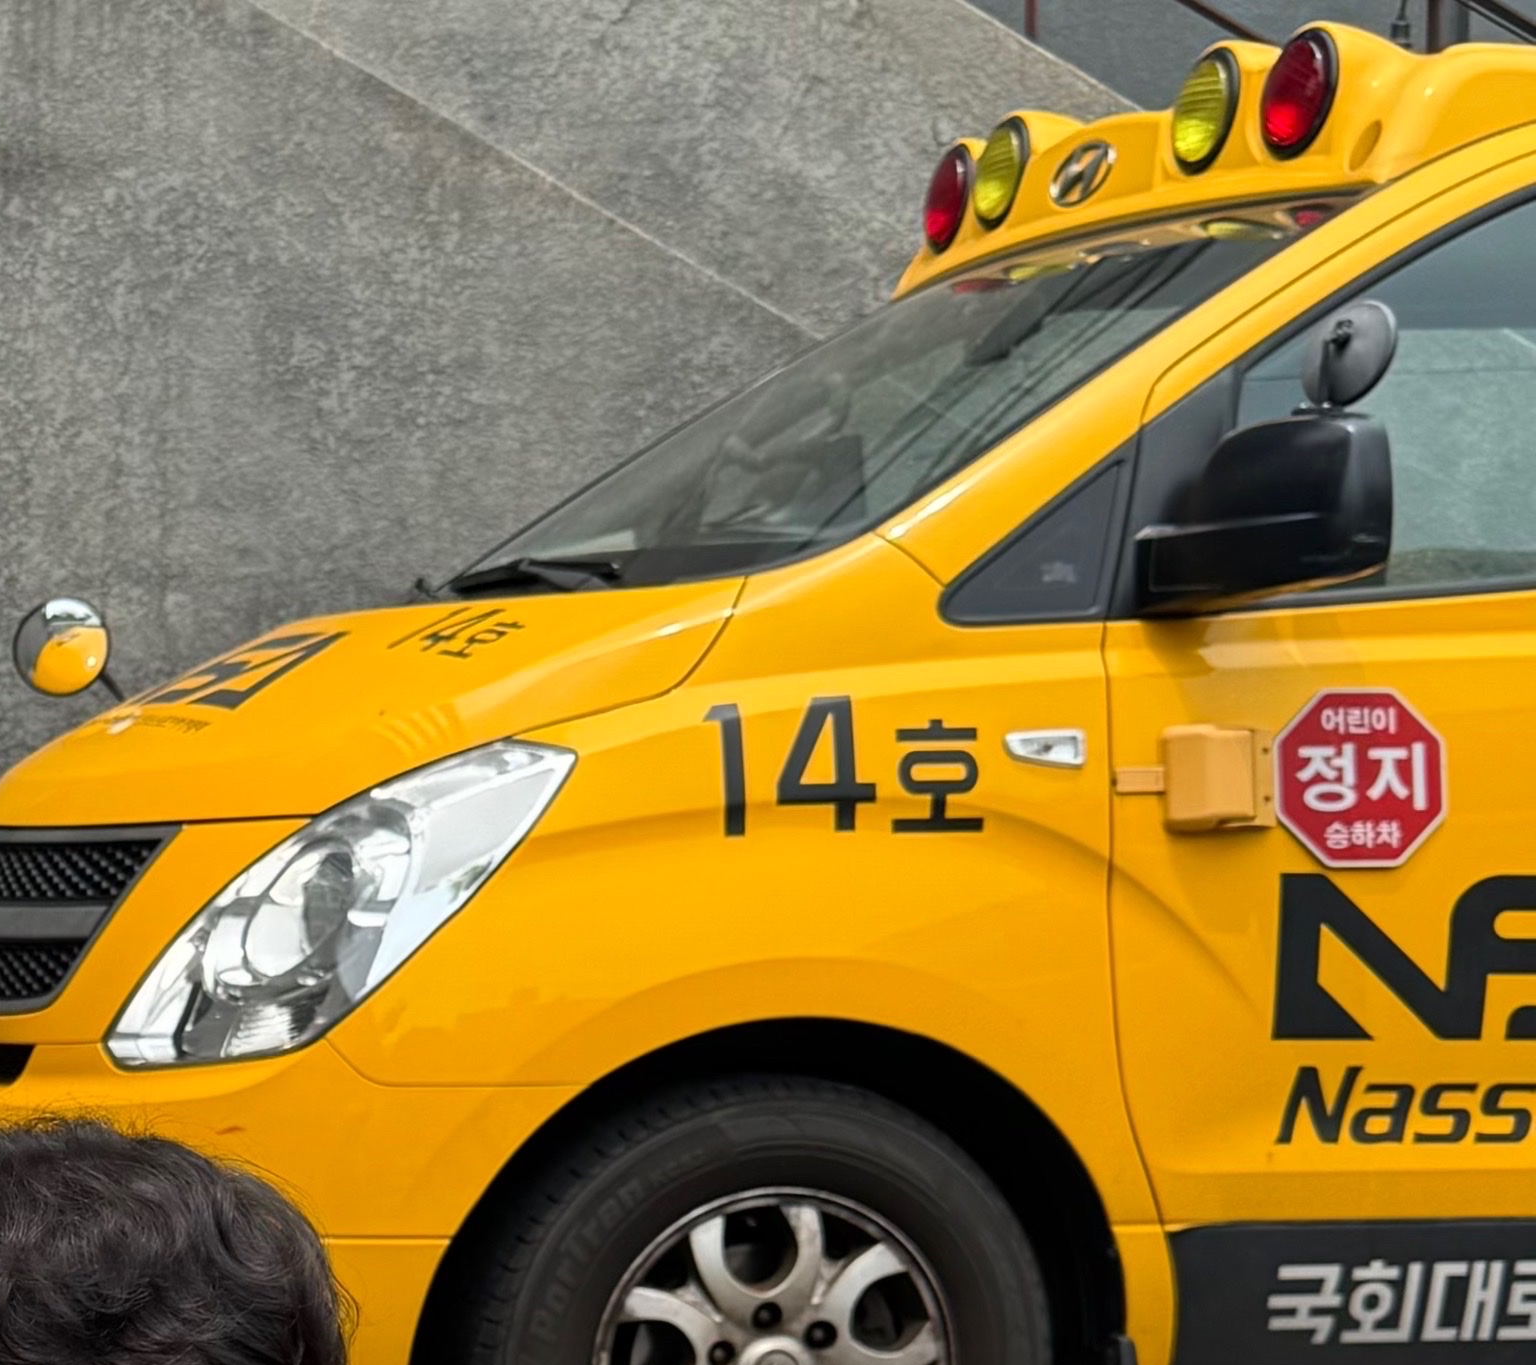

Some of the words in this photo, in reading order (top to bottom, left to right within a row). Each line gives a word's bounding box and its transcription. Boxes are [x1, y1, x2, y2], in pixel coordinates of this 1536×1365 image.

[1320, 706, 1397, 735] 어린이
[703, 695, 984, 837] 14호
[1295, 741, 1429, 813] 정지
[1323, 820, 1402, 850] 승하차
[1275, 1065, 1536, 1145] Nass
